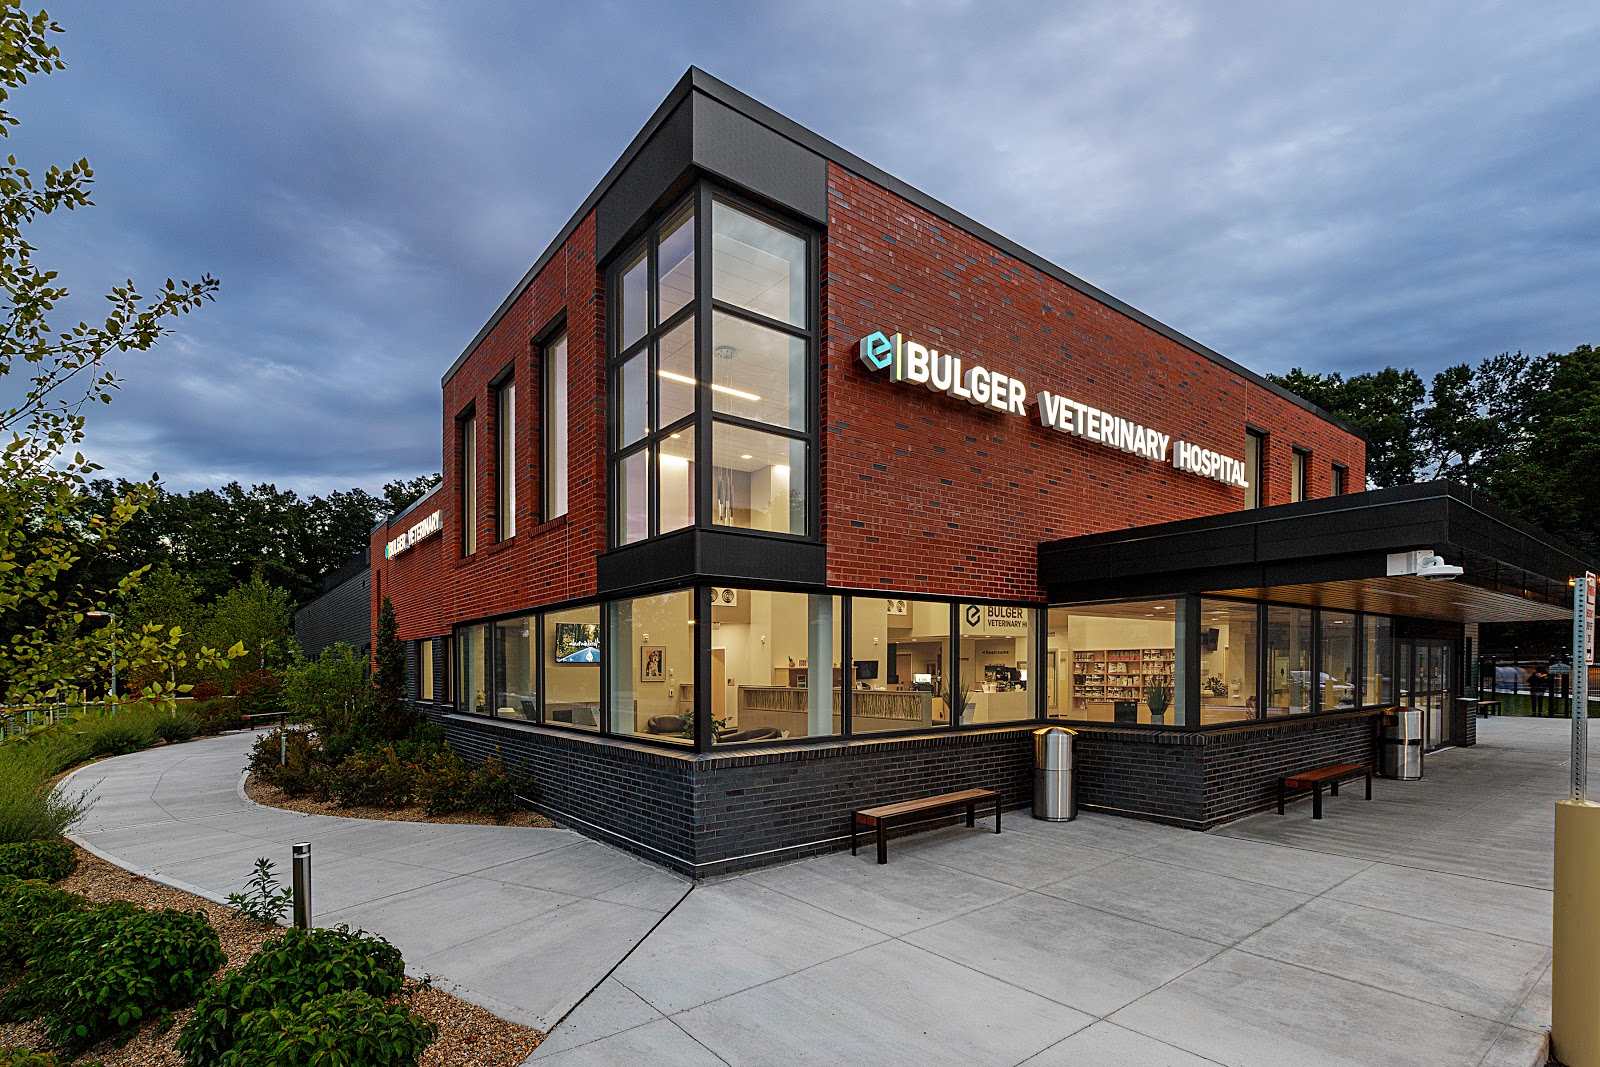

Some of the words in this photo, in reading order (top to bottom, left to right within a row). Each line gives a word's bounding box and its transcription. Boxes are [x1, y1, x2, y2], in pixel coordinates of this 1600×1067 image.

[905, 341, 1027, 417] BULGER
[1039, 391, 1170, 462] VETERINARY
[1176, 440, 1249, 488] HOSPITAL
[408, 509, 441, 546] VETERINARY
[987, 606, 1023, 618] BULGER
[988, 619, 1021, 627] VETERINARY
